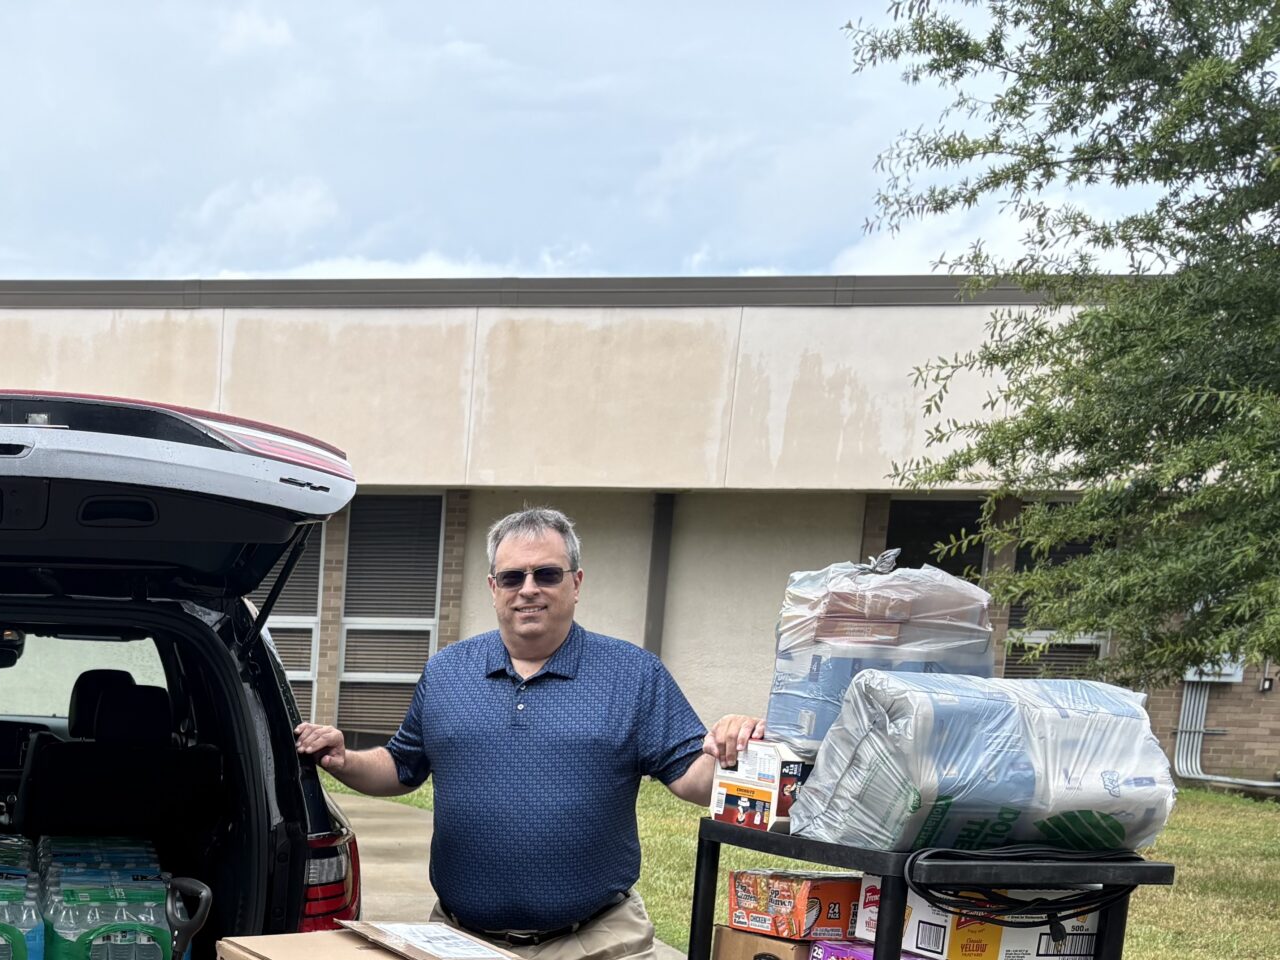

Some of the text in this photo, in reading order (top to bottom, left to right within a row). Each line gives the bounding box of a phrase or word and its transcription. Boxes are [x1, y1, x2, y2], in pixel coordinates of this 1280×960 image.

[829, 903, 839, 914] 24
[813, 946, 824, 959] 25
[960, 943, 988, 953] YELLOW
